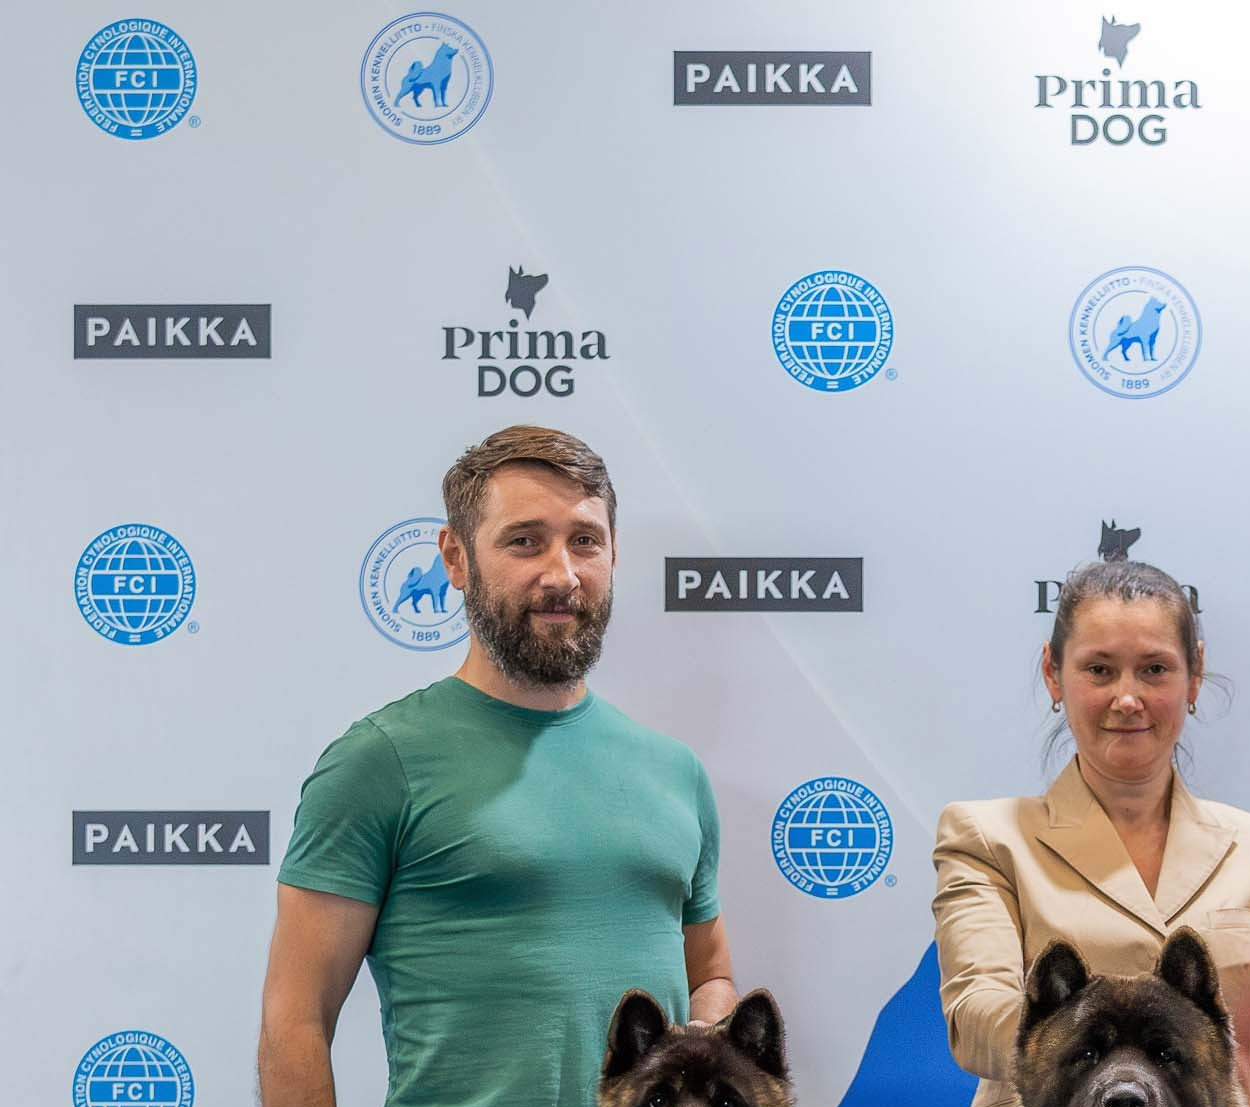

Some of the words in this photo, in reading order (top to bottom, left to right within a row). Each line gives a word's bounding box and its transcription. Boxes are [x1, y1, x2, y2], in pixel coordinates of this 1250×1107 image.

[84, 21, 168, 59] CYNOLOGIQUE
[154, 34, 195, 133] INTERNATIONALE
[115, 70, 158, 88] FCI
[686, 63, 859, 93] PAIKKA
[1034, 68, 1204, 109] Prima
[370, 85, 403, 127] SUOMEN
[412, 124, 441, 136] 1889
[1071, 114, 1168, 146] DOG
[86, 316, 259, 346] PAIKKA
[441, 319, 611, 360] Prima
[780, 273, 864, 311] CYNOLOGIQUE
[850, 286, 891, 385] INTERNATIONALE
[811, 322, 854, 340] FCI
[478, 365, 575, 397] DOG
[83, 526, 167, 564] CYNOLOGIQUE
[153, 539, 194, 638] INTERNATIONALE
[114, 575, 157, 593] FCI
[677, 569, 850, 599] PAIKKA
[369, 591, 402, 633] SUOMEN
[411, 630, 440, 642] 1889
[84, 823, 257, 853] PAIKKA
[780, 780, 864, 818] CYNOLOGIQUE
[850, 793, 891, 892] INTERNATIONALE
[811, 829, 854, 847] FCI
[81, 1033, 165, 1071] CYNOLOGIQUE
[112, 1082, 155, 1100] FCI
